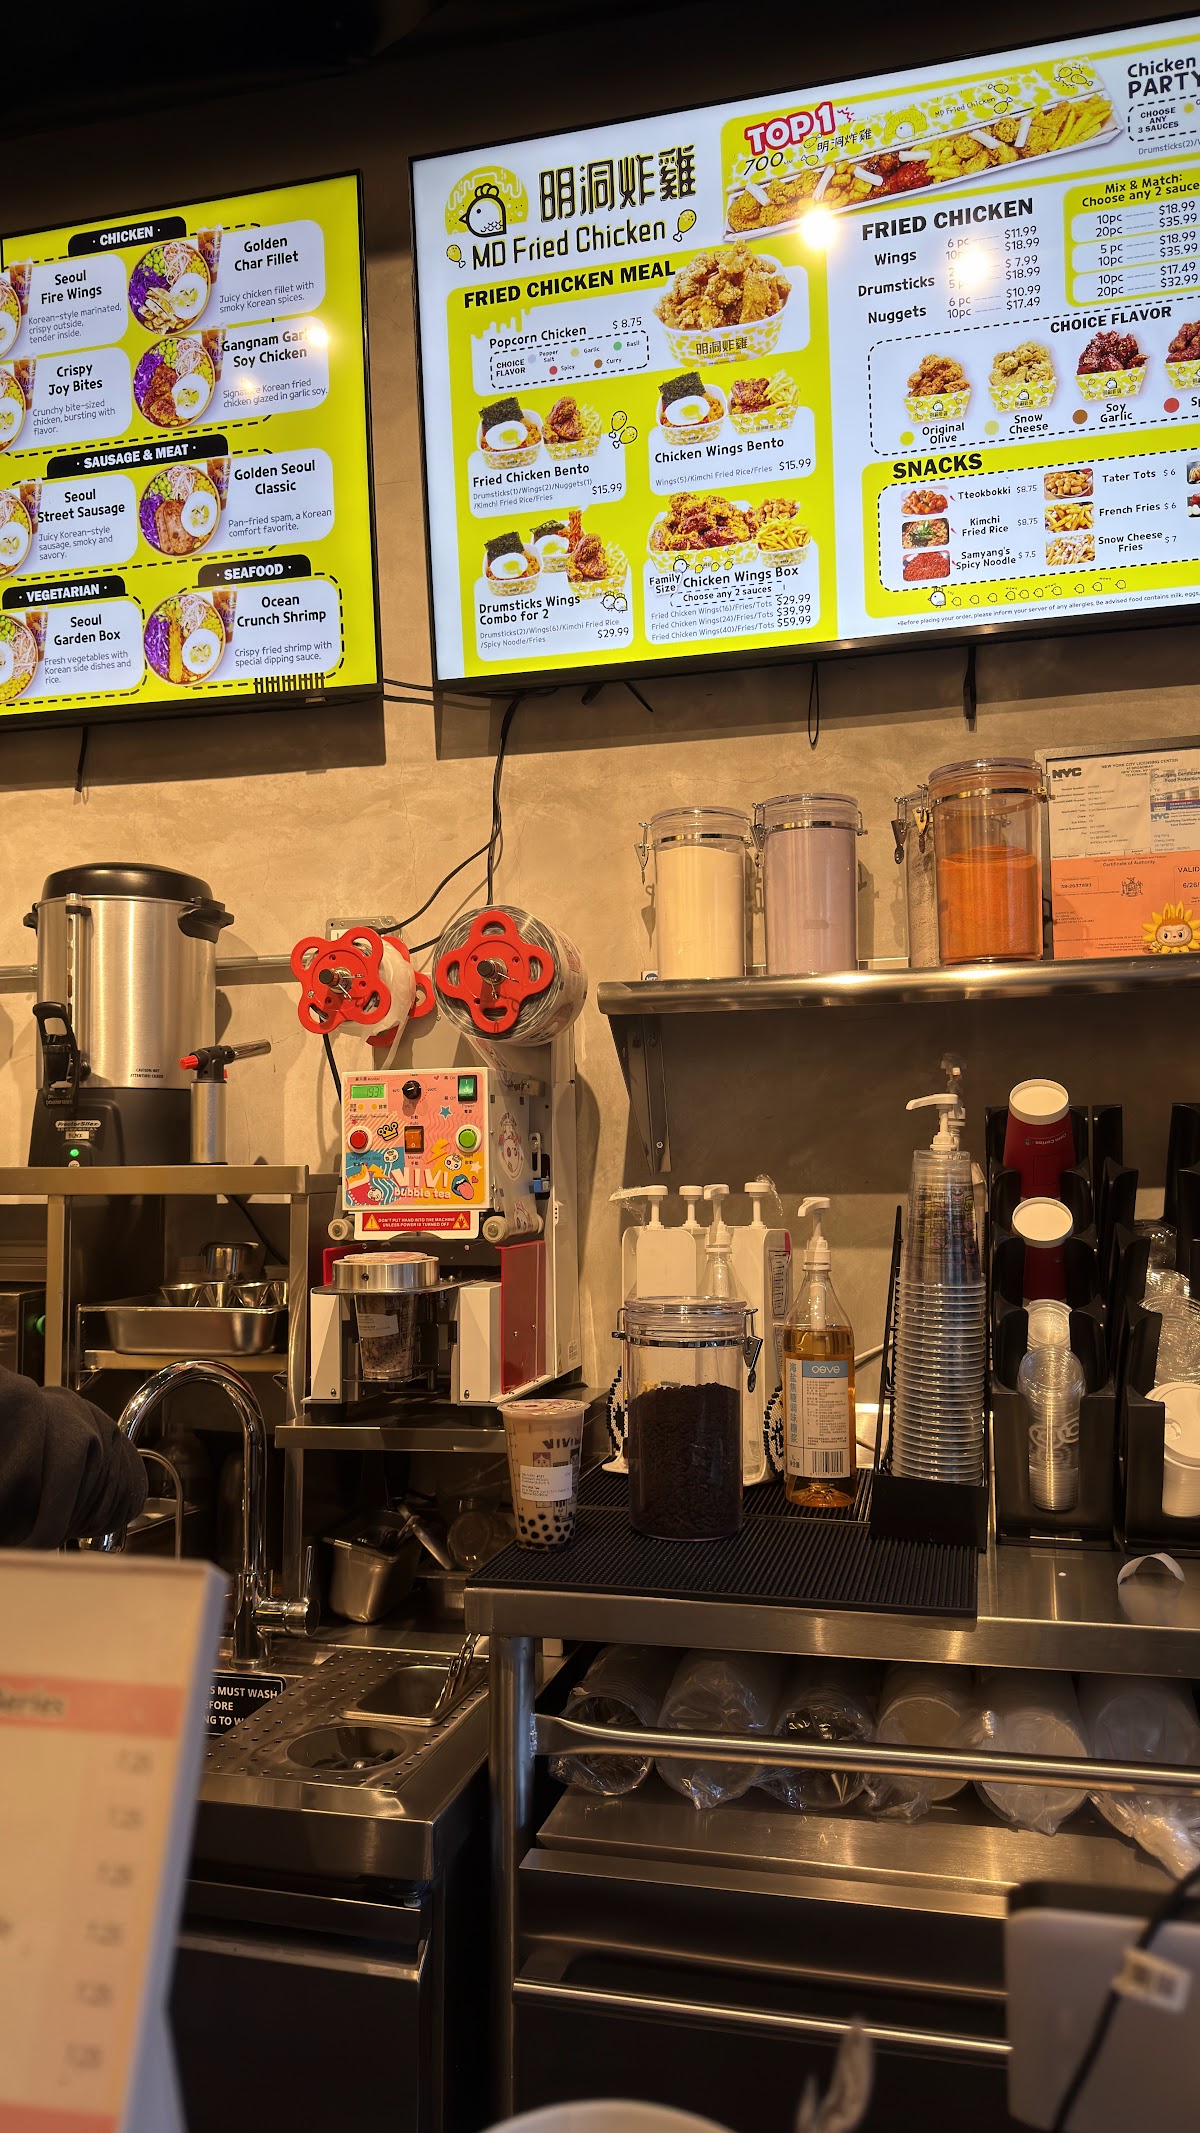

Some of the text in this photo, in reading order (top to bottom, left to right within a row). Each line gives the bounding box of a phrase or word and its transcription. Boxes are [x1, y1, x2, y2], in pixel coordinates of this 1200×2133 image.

[1128, 57, 1196, 78] Chicken
[1128, 70, 1200, 99] PARTY
[946, 104, 964, 114] Fried
[967, 97, 995, 108] Chicken
[1140, 107, 1176, 118] CHOOSE
[1145, 121, 1179, 132] SAUCES
[1149, 115, 1167, 124] ANY
[817, 128, 872, 152] 明洞炸雞
[538, 145, 696, 223] 明洞炸雞
[1105, 174, 1182, 194] Mix & Match:
[1159, 201, 1195, 215] $18.99
[862, 198, 1033, 240] FRIED CHICKEN
[99, 226, 153, 246] CHICKEN
[948, 226, 1037, 248] 6 pc $11.99
[244, 236, 288, 253] Golden
[472, 219, 665, 270] MD Fried Chicken
[234, 251, 298, 272] Char Fillet
[874, 251, 916, 266] Wings
[54, 270, 87, 286] Seoul
[464, 260, 675, 309] FRIED CHICKEN MEAL
[219, 281, 314, 306] Juicy chicken fillet with
[858, 276, 935, 297] Drumsticks
[41, 286, 102, 304] Fire Wings
[219, 293, 304, 314] smoky Korean spices.
[1007, 297, 1040, 310] $17.49
[868, 305, 926, 324] Nuggets
[1050, 306, 1172, 333] CHOICE FLAVOR
[490, 317, 642, 349] Popcorn Chicken $ 8.75
[222, 335, 278, 351] Gangnam
[234, 349, 307, 368] Soy Chicken
[497, 359, 524, 368] CHOICE
[606, 357, 622, 365] Curry
[56, 363, 93, 379] Crispy
[496, 367, 526, 377] FLAVOR
[48, 378, 102, 397] Joy Bites
[1014, 414, 1043, 424] Snow
[922, 423, 965, 436] Original
[1009, 422, 1049, 435] Cheese
[930, 434, 957, 444] Olive
[83, 444, 189, 470] SAUSAGE & MEAT
[654, 438, 812, 471] Chicken Wings Bento $15.99
[234, 459, 315, 480] Golden Seoul
[893, 453, 982, 479] SNACKS
[473, 463, 590, 488] Fried Chicken Bento
[1102, 470, 1156, 483] Tater Tots
[255, 479, 297, 495] Classic
[592, 482, 623, 496] $15.99
[958, 487, 1011, 499] Tteokbokki
[64, 488, 96, 503] Seoul
[38, 501, 125, 523] Street Sausage
[1100, 503, 1160, 516] French Fries
[970, 516, 1000, 526] Kimchi
[962, 525, 1009, 537] Fried Rice
[962, 547, 1010, 560] Samyang's
[223, 562, 284, 581] SEAFOOD
[956, 557, 1016, 571] Spicy Noodle
[649, 574, 681, 587] Family
[683, 566, 799, 588] Chicken Wings Box
[26, 583, 99, 602] VEGETARIAN
[655, 583, 677, 595] Size
[683, 586, 772, 602] Choose any 2 sauces
[261, 594, 300, 608] Ocean
[479, 594, 581, 613] Drumsticks Wings
[777, 594, 811, 606] $29.99
[237, 608, 327, 628] Crunch Shrimp
[480, 609, 549, 626] Combo for 2
[777, 605, 811, 617] $39.99
[70, 614, 102, 628] Seoul
[777, 616, 811, 628] $59.99
[54, 628, 121, 646] Garden Box
[597, 628, 629, 639] $29.99
[1052, 768, 1081, 778] NYC
[391, 1167, 448, 1188] VIVI
[394, 1188, 451, 1198] bubble tea
[218, 1687, 245, 1697] MUST
[248, 1689, 277, 1699] WASH
[219, 1716, 232, 1725] TO
